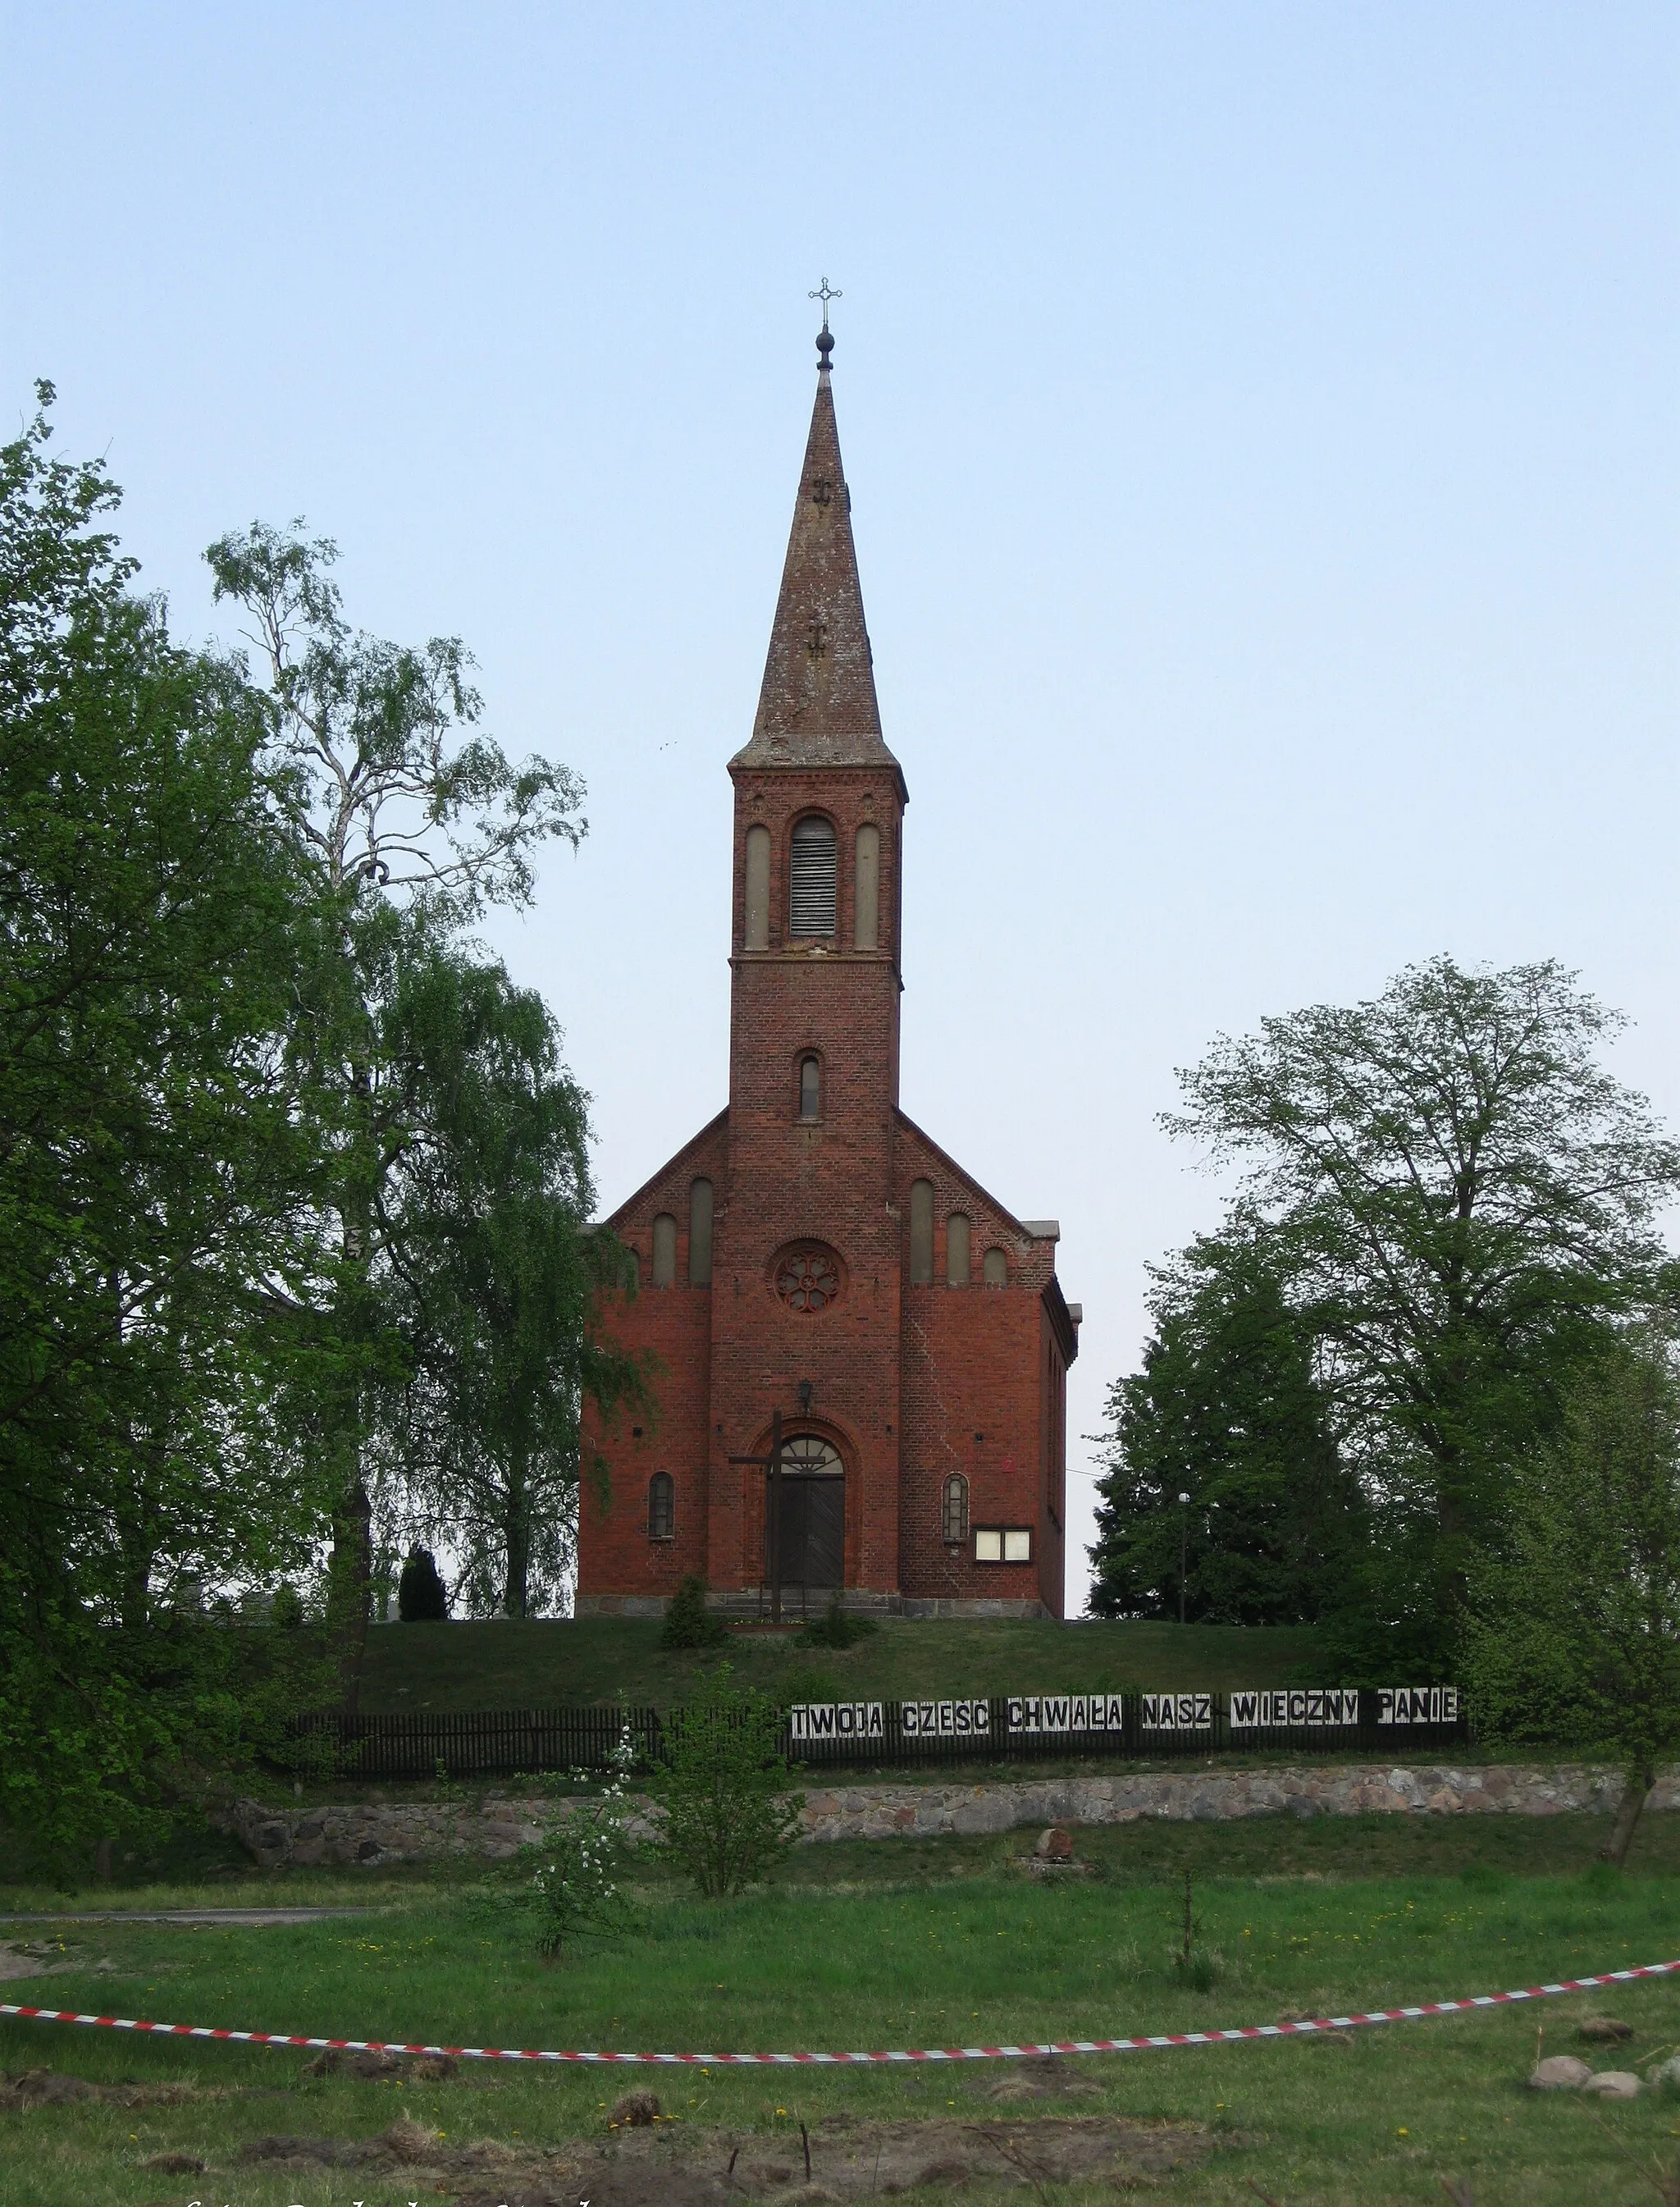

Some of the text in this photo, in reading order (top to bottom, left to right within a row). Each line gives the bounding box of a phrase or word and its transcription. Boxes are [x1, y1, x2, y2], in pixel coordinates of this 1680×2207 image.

[792, 1707, 882, 1734] TWOJA
[1009, 1699, 1121, 1727] CHWAŁA
[1143, 1699, 1210, 1724] NASZ
[1233, 1694, 1358, 1722] WIECZNY
[1377, 1692, 1458, 1718] PANIE
